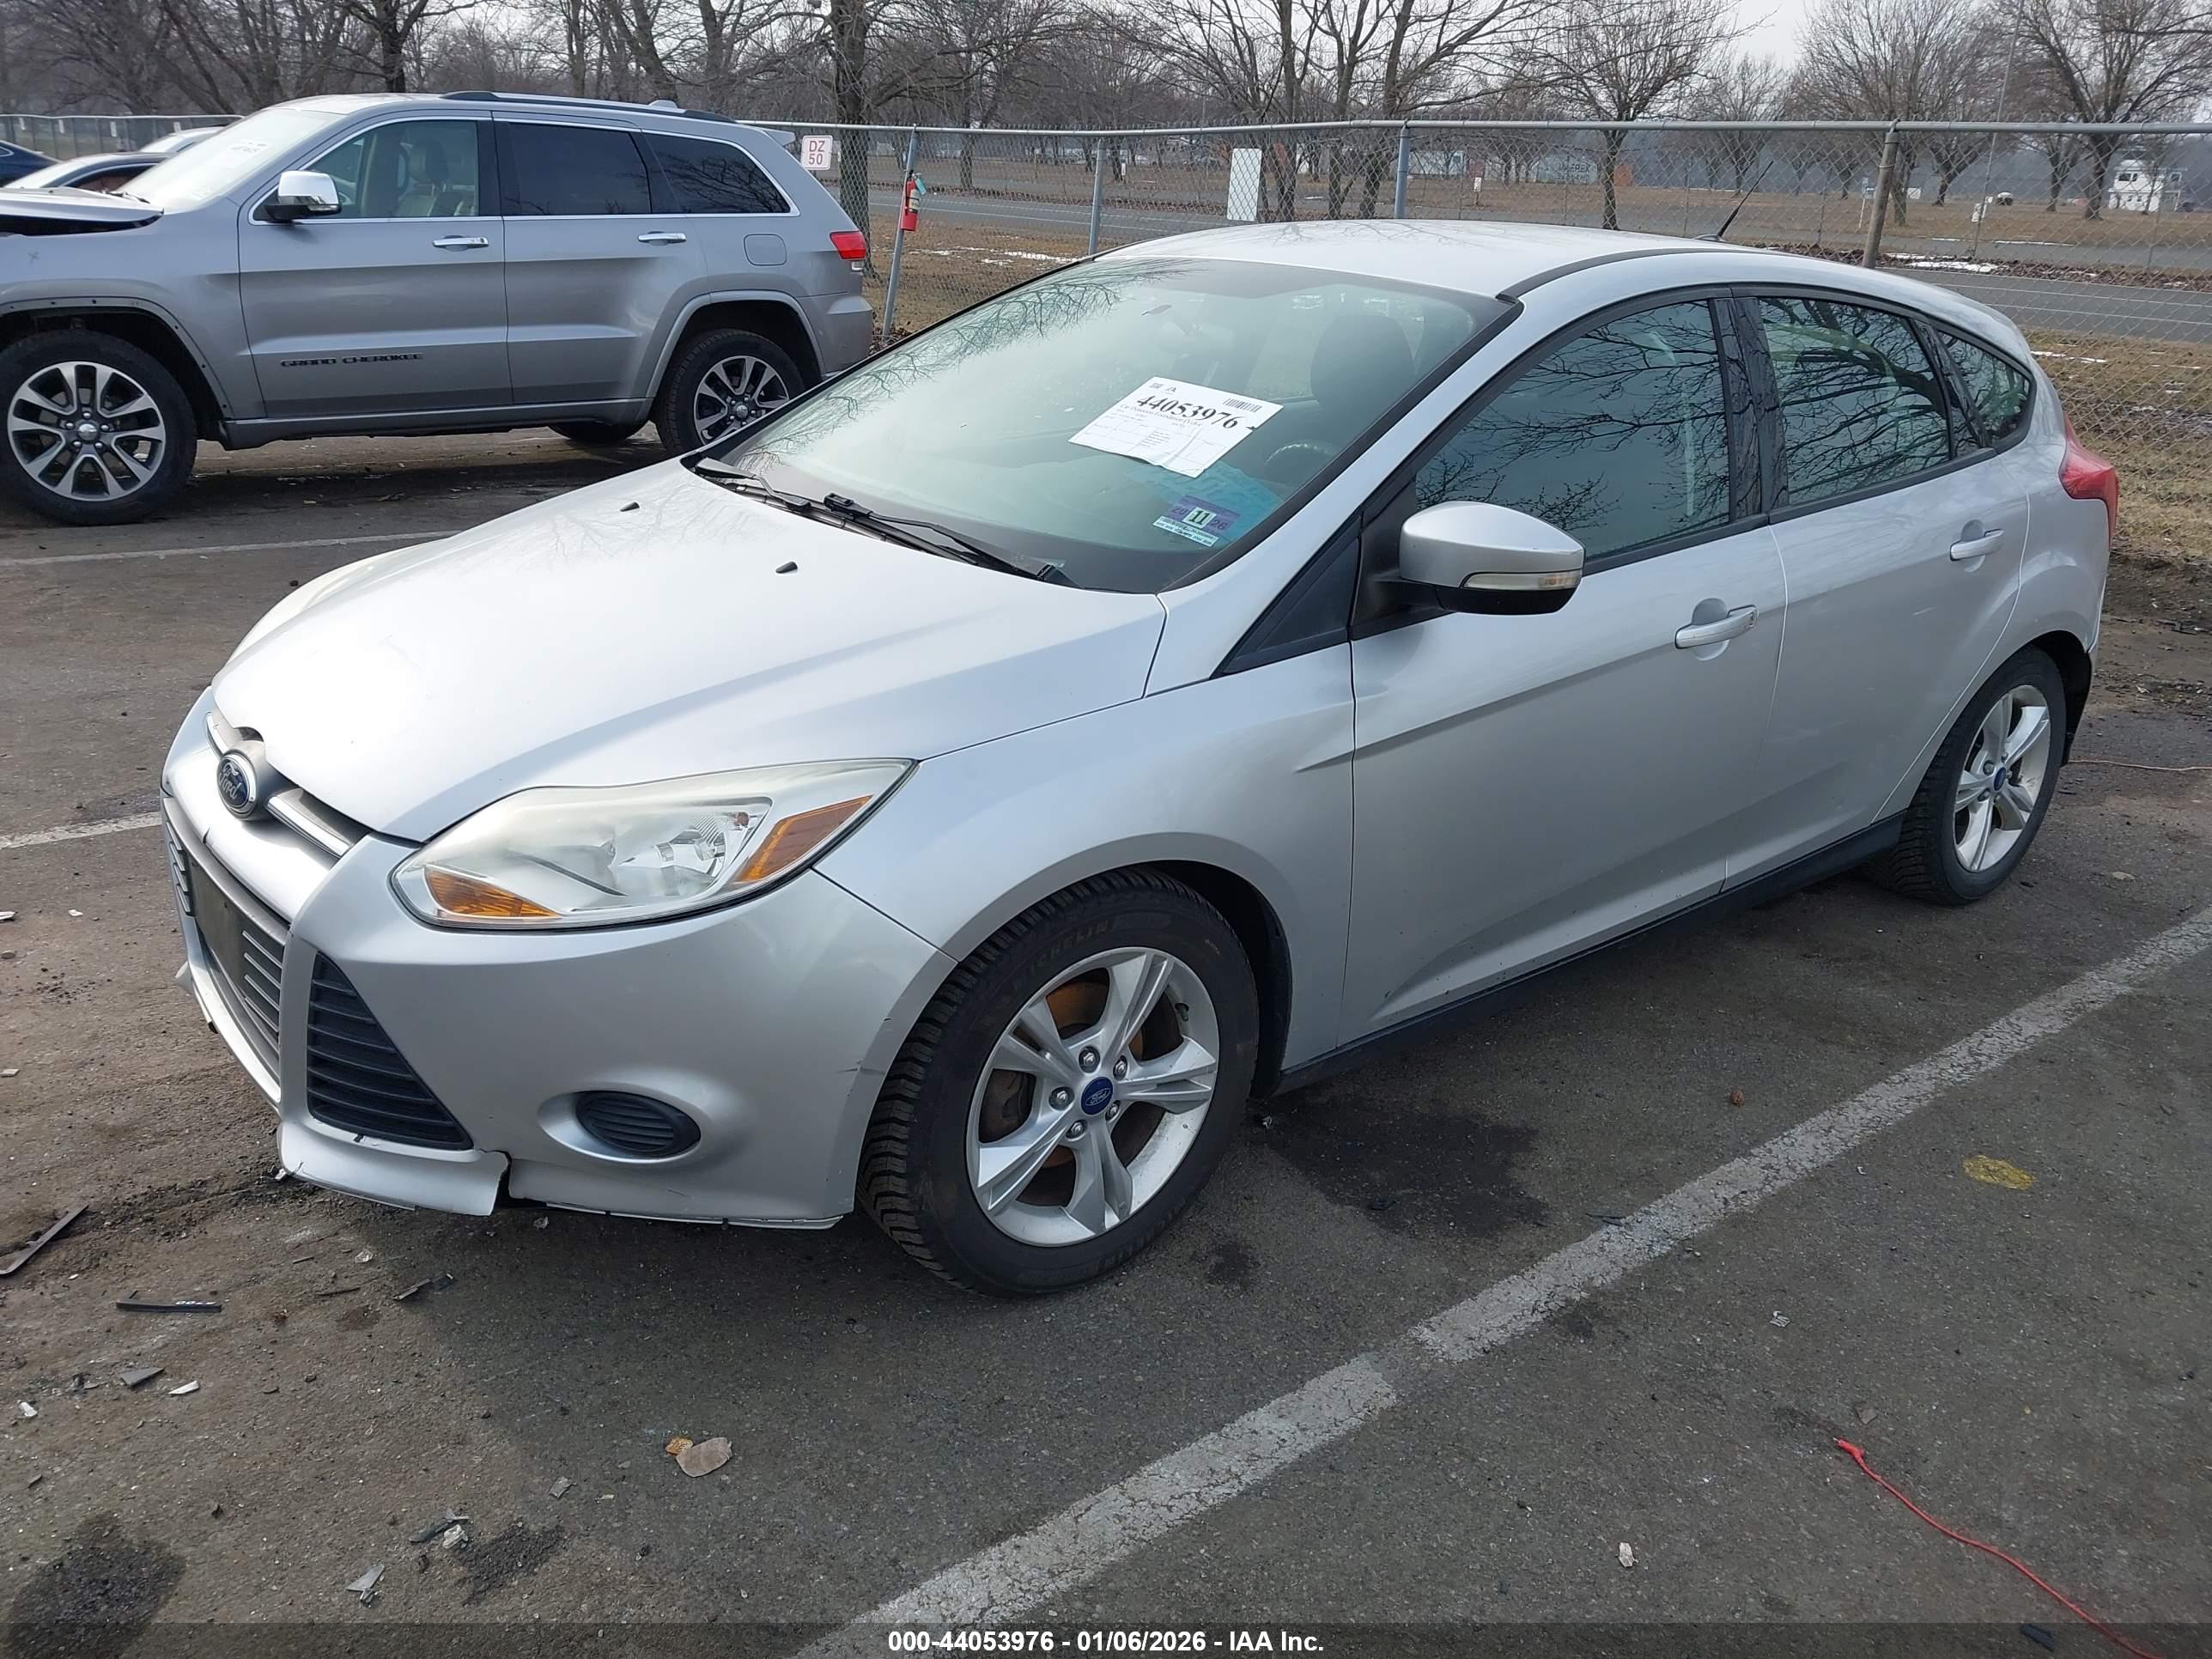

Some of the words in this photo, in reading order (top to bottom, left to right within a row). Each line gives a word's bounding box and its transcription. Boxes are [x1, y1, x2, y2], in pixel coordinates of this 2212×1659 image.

[809, 140, 825, 152] DZ
[809, 153, 823, 165] 50
[342, 354, 423, 364] CHEROKEE
[1137, 395, 1245, 428] 44053976
[1188, 510, 1210, 525] 11
[1209, 519, 1228, 530] 26
[219, 762, 242, 799] Ford
[1089, 1090, 1108, 1105] Ford
